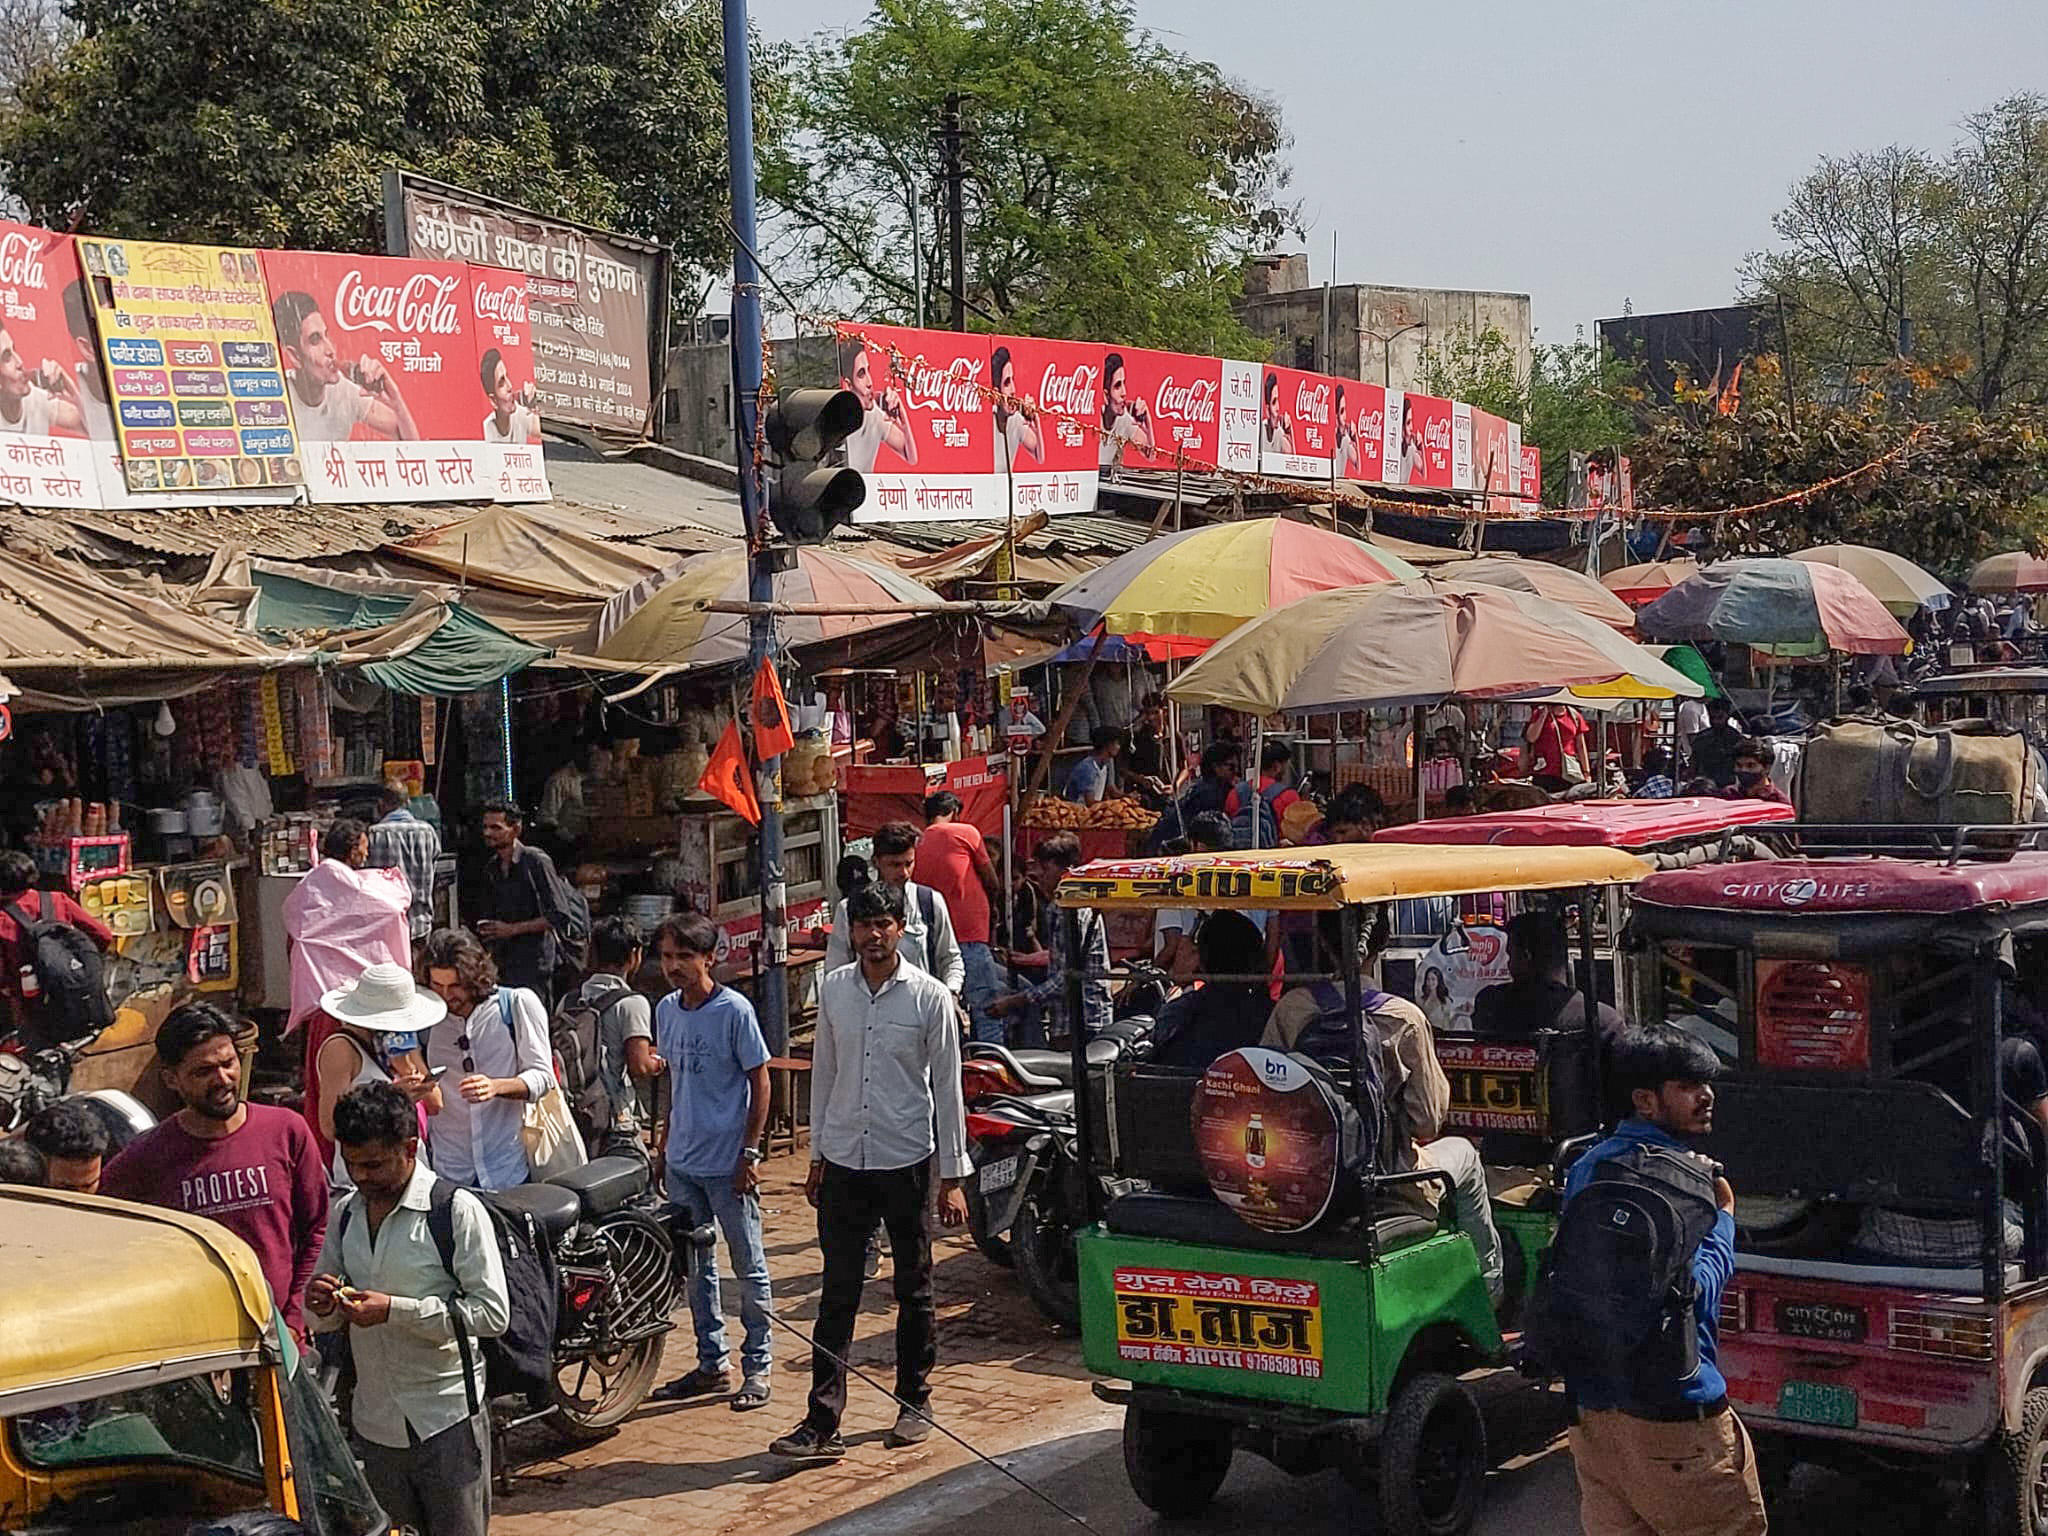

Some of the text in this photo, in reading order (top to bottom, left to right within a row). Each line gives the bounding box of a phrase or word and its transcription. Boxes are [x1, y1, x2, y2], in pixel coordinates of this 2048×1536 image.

[414, 206, 488, 261] अंग्रेजी
[495, 235, 547, 275] शराब
[551, 237, 581, 282] की
[584, 253, 638, 304] दुकान
[335, 270, 461, 334] Coca-Cola
[172, 343, 214, 364] इडली
[380, 338, 421, 363] खुद को
[403, 353, 442, 372] जगाओ
[906, 354, 984, 413] Coca-Cola
[1040, 362, 1098, 415] Coca-Cola
[1155, 375, 1219, 423] Coca-Cola
[1224, 407, 1258, 431] टूर एण्ड
[5, 438, 65, 467] कोहली
[325, 443, 475, 488] श्री राम पेठा स्टोर
[0, 469, 83, 498] पेठा स्टोर
[498, 471, 512, 495] टी
[877, 478, 973, 511] वैष्णो भोजनालय
[1017, 474, 1080, 511] ठाकुर जी पेठा
[1723, 884, 1780, 897] CITY
[1819, 883, 1869, 897] LIFE
[1265, 1057, 1287, 1075] bn
[1206, 1079, 1232, 1090] Kachi
[1233, 1081, 1261, 1095] Ghani
[181, 1166, 268, 1210] PROTEST
[1116, 1272, 1176, 1290] गुप्त
[1184, 1275, 1241, 1293] रोगी
[1251, 1280, 1315, 1299] मिलें
[1184, 1346, 1243, 1368] आगरा
